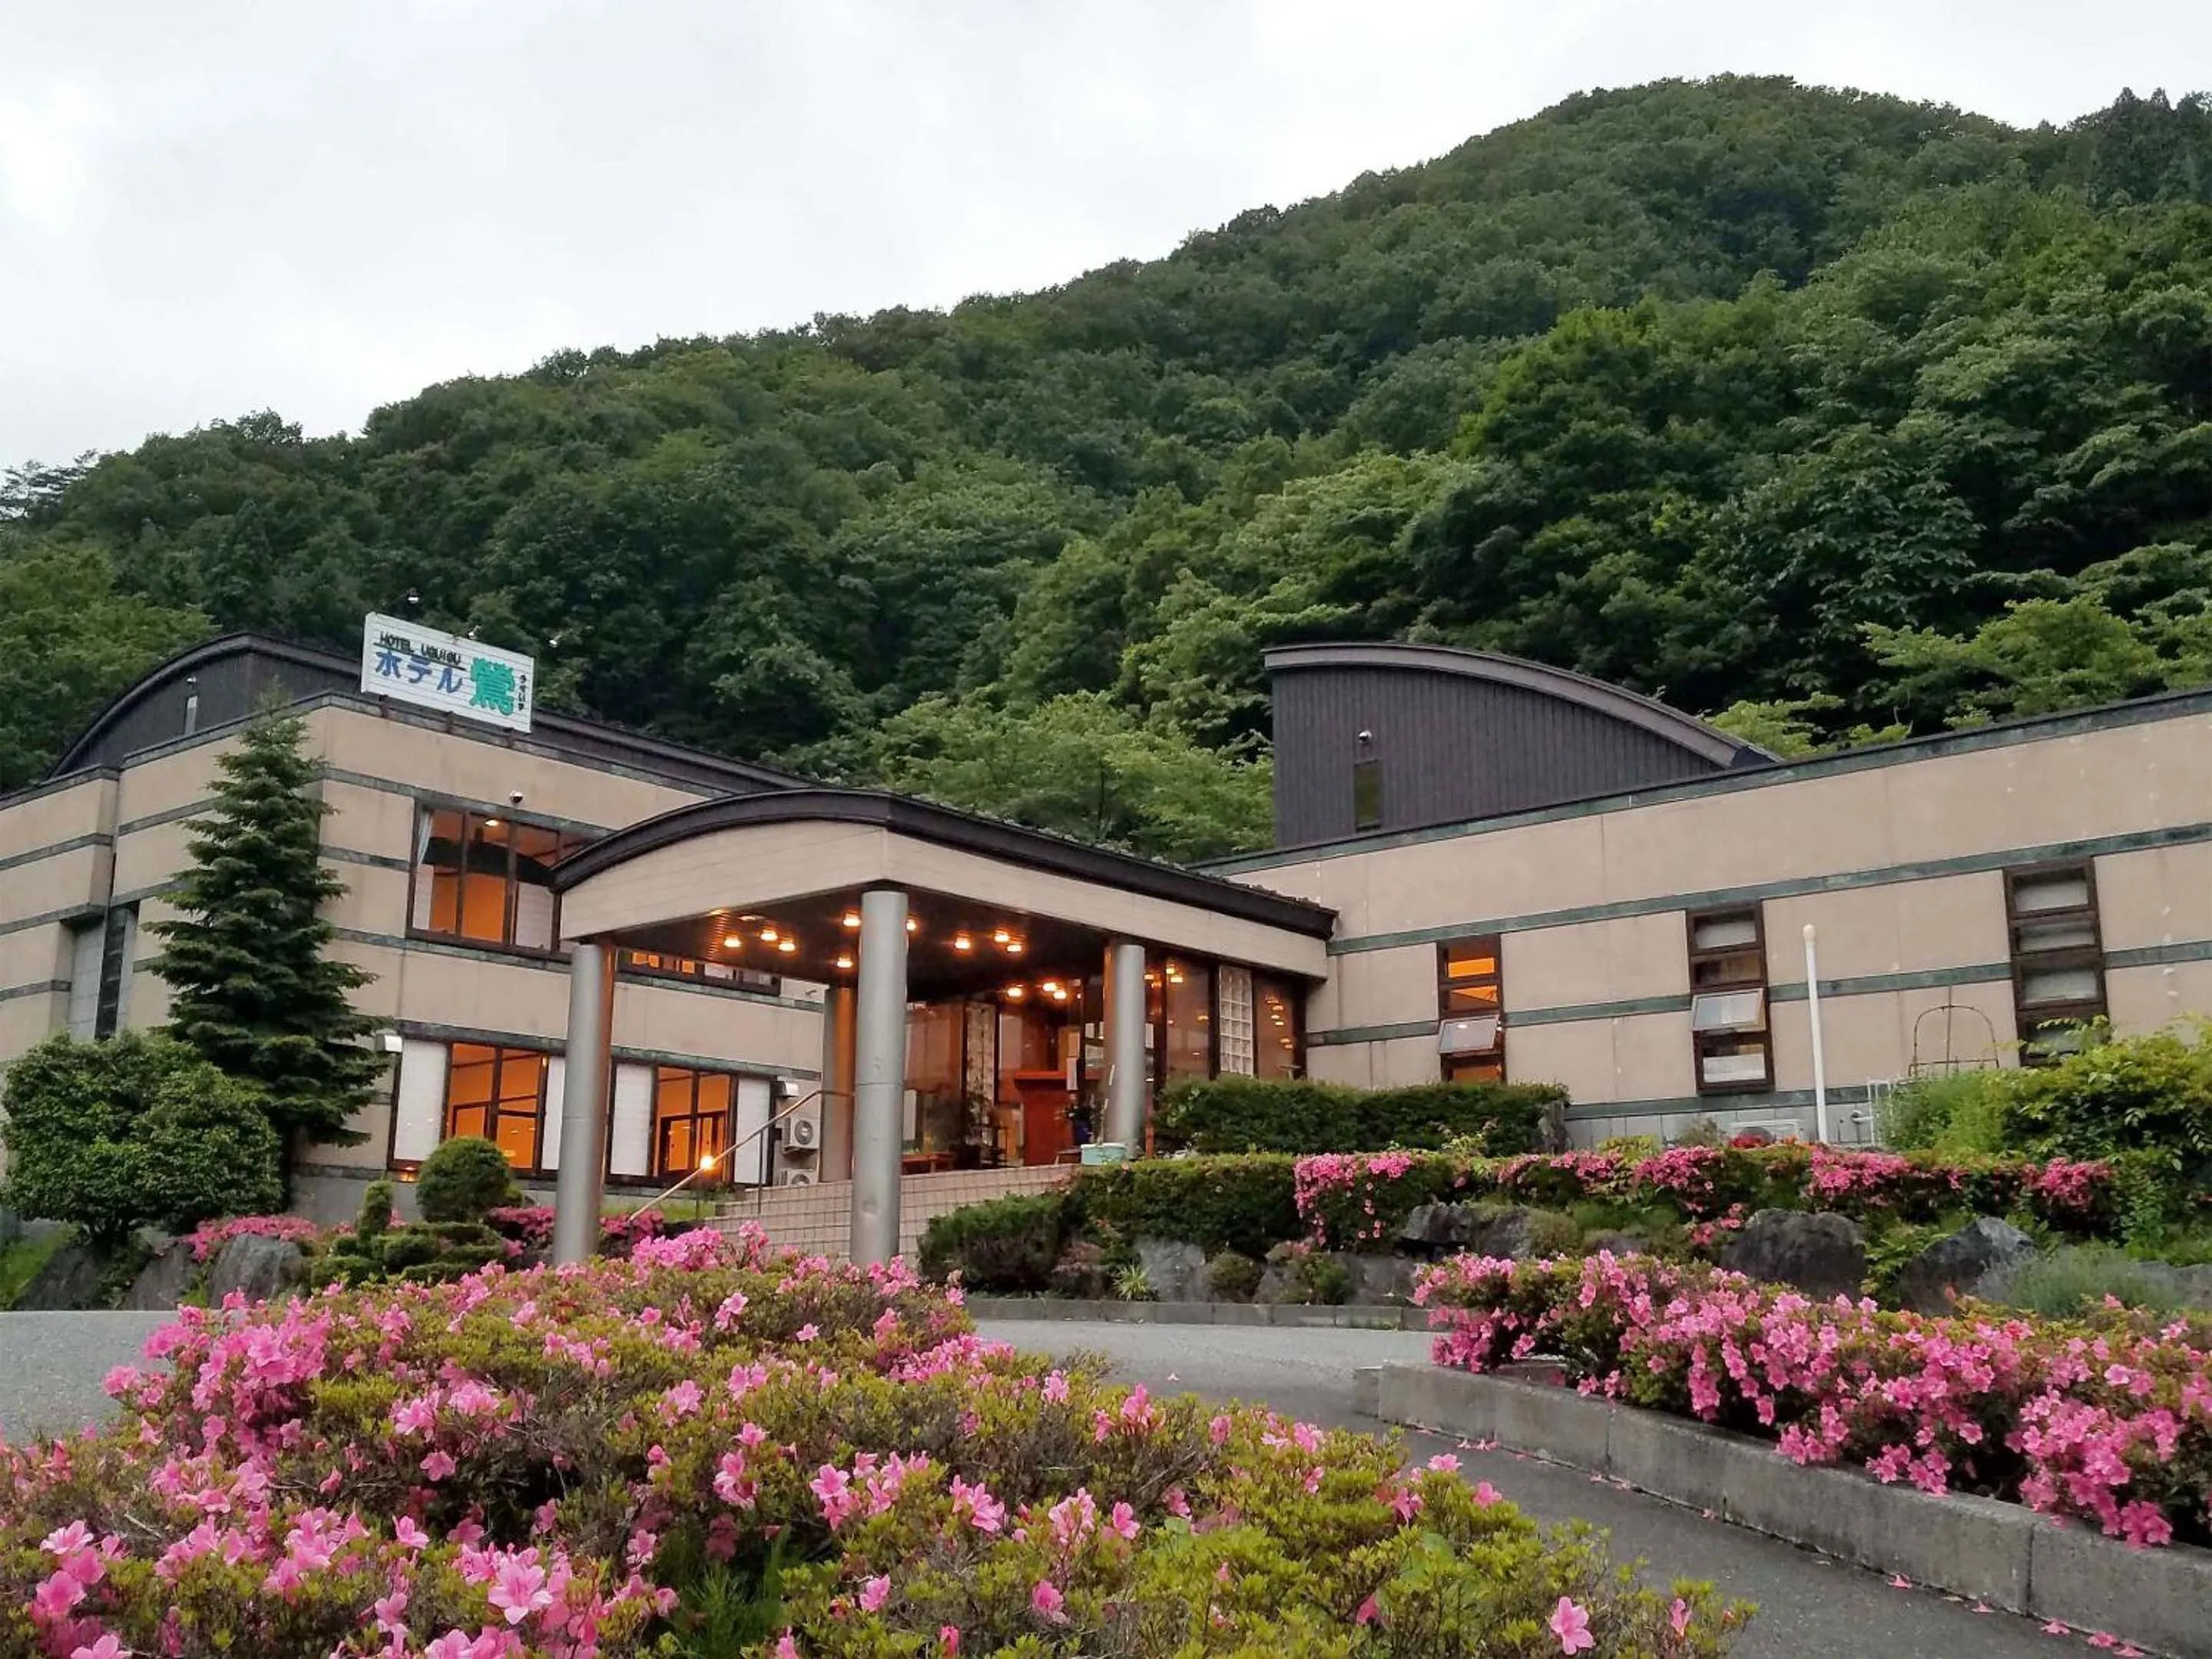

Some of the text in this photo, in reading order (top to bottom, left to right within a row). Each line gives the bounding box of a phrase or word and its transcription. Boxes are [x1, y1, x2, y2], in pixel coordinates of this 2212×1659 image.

[379, 631, 415, 653] HOTEL
[375, 647, 462, 694] ホテル
